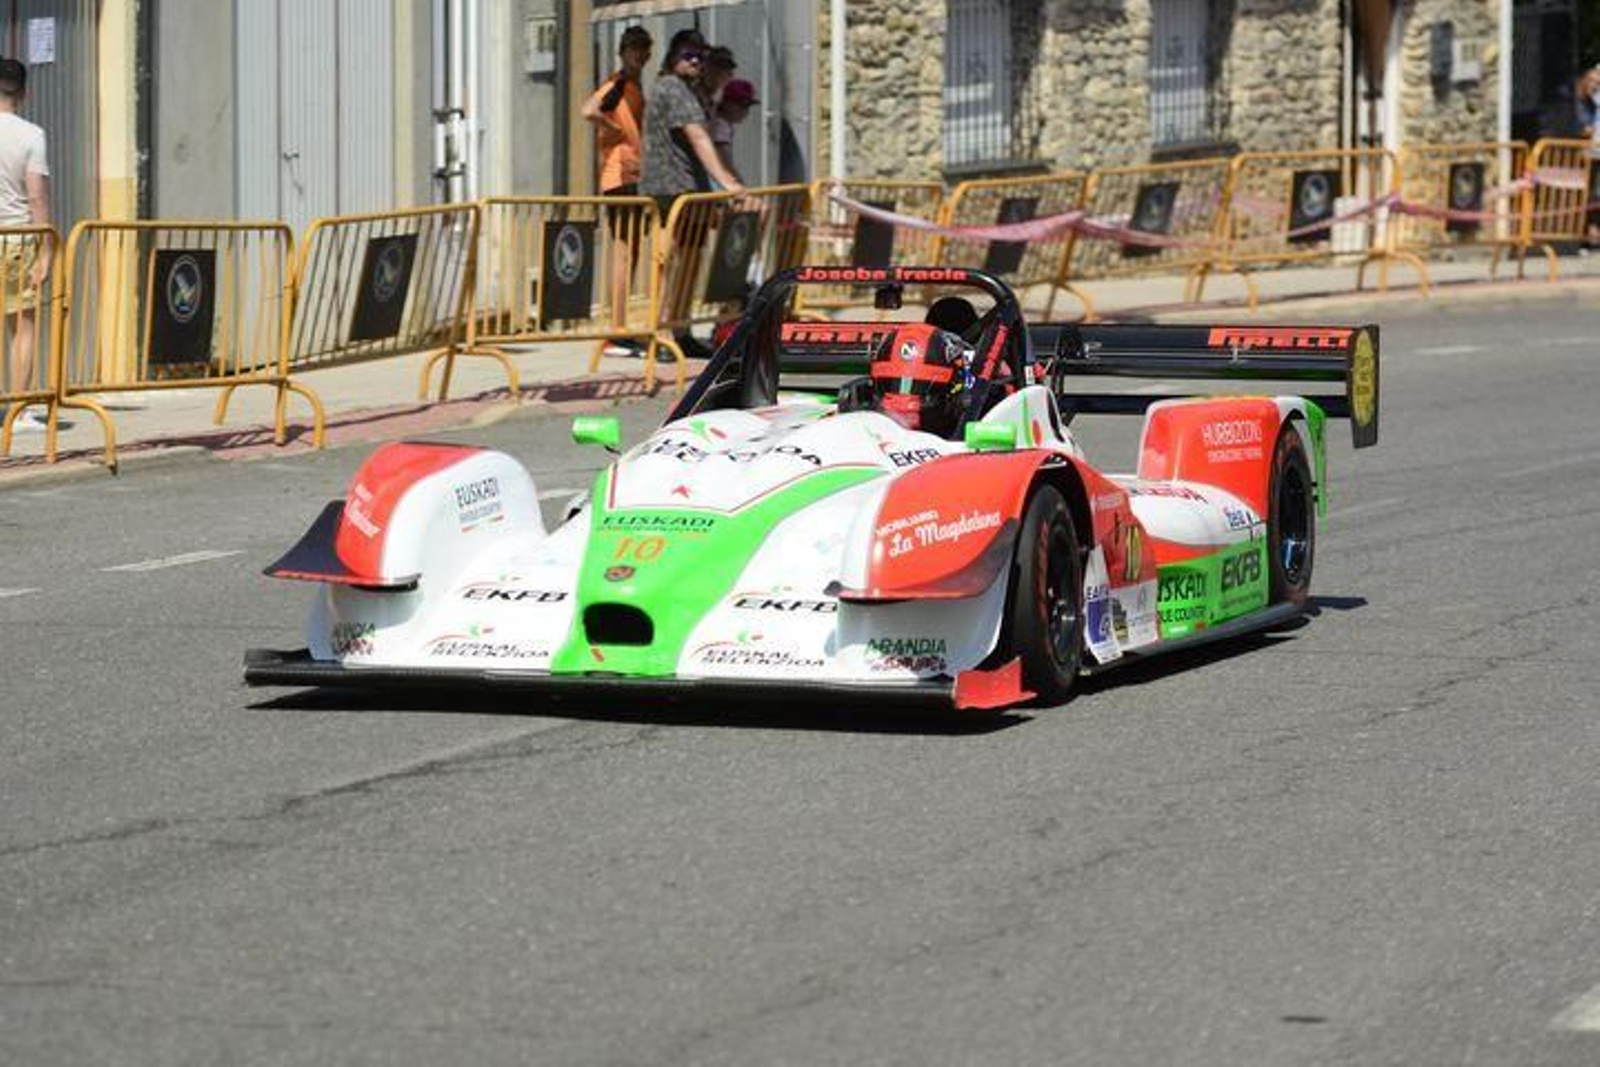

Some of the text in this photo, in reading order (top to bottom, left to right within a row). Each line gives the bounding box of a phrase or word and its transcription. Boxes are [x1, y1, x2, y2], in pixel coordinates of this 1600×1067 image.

[915, 509, 1001, 547] Magdalena
[615, 535, 667, 561] 10
[1221, 548, 1261, 591] EKFB
[463, 588, 569, 603] EKFB
